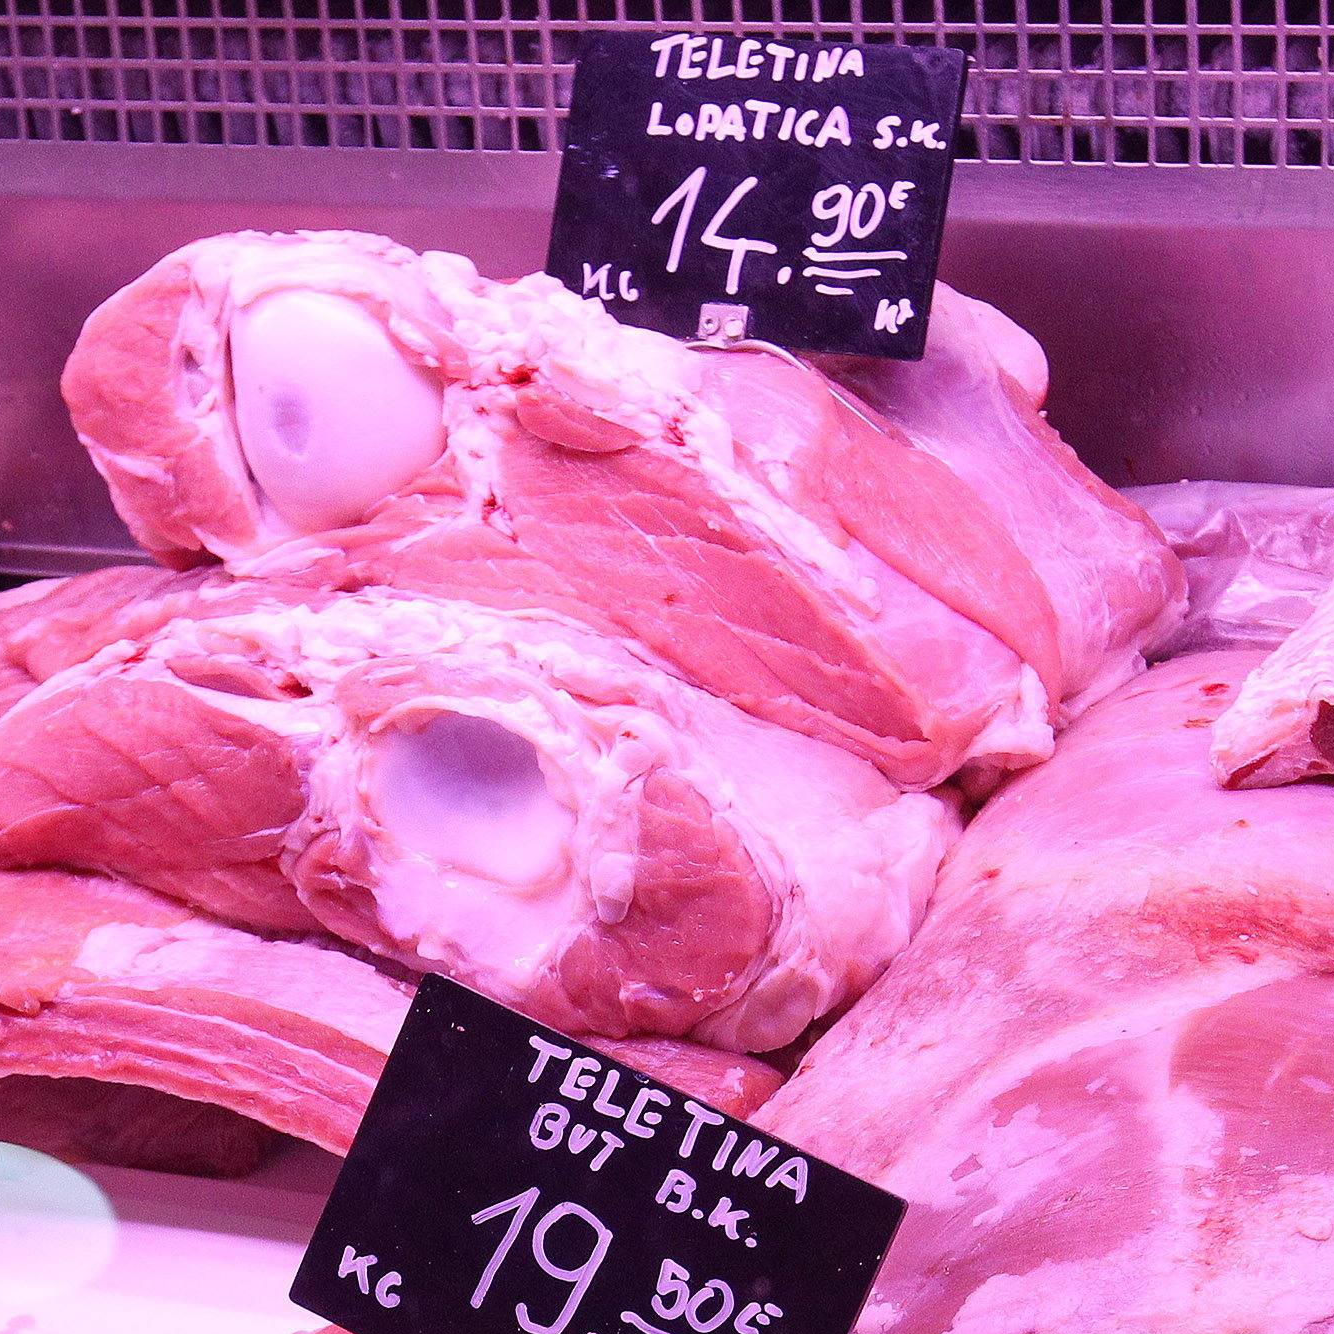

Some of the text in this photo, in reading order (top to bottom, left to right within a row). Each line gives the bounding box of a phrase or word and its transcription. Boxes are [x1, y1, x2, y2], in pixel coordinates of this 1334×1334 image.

[650, 32, 865, 83] TELETINA
[527, 1035, 810, 1204] TELETINA
[529, 1102, 758, 1249] BUT B.K.
